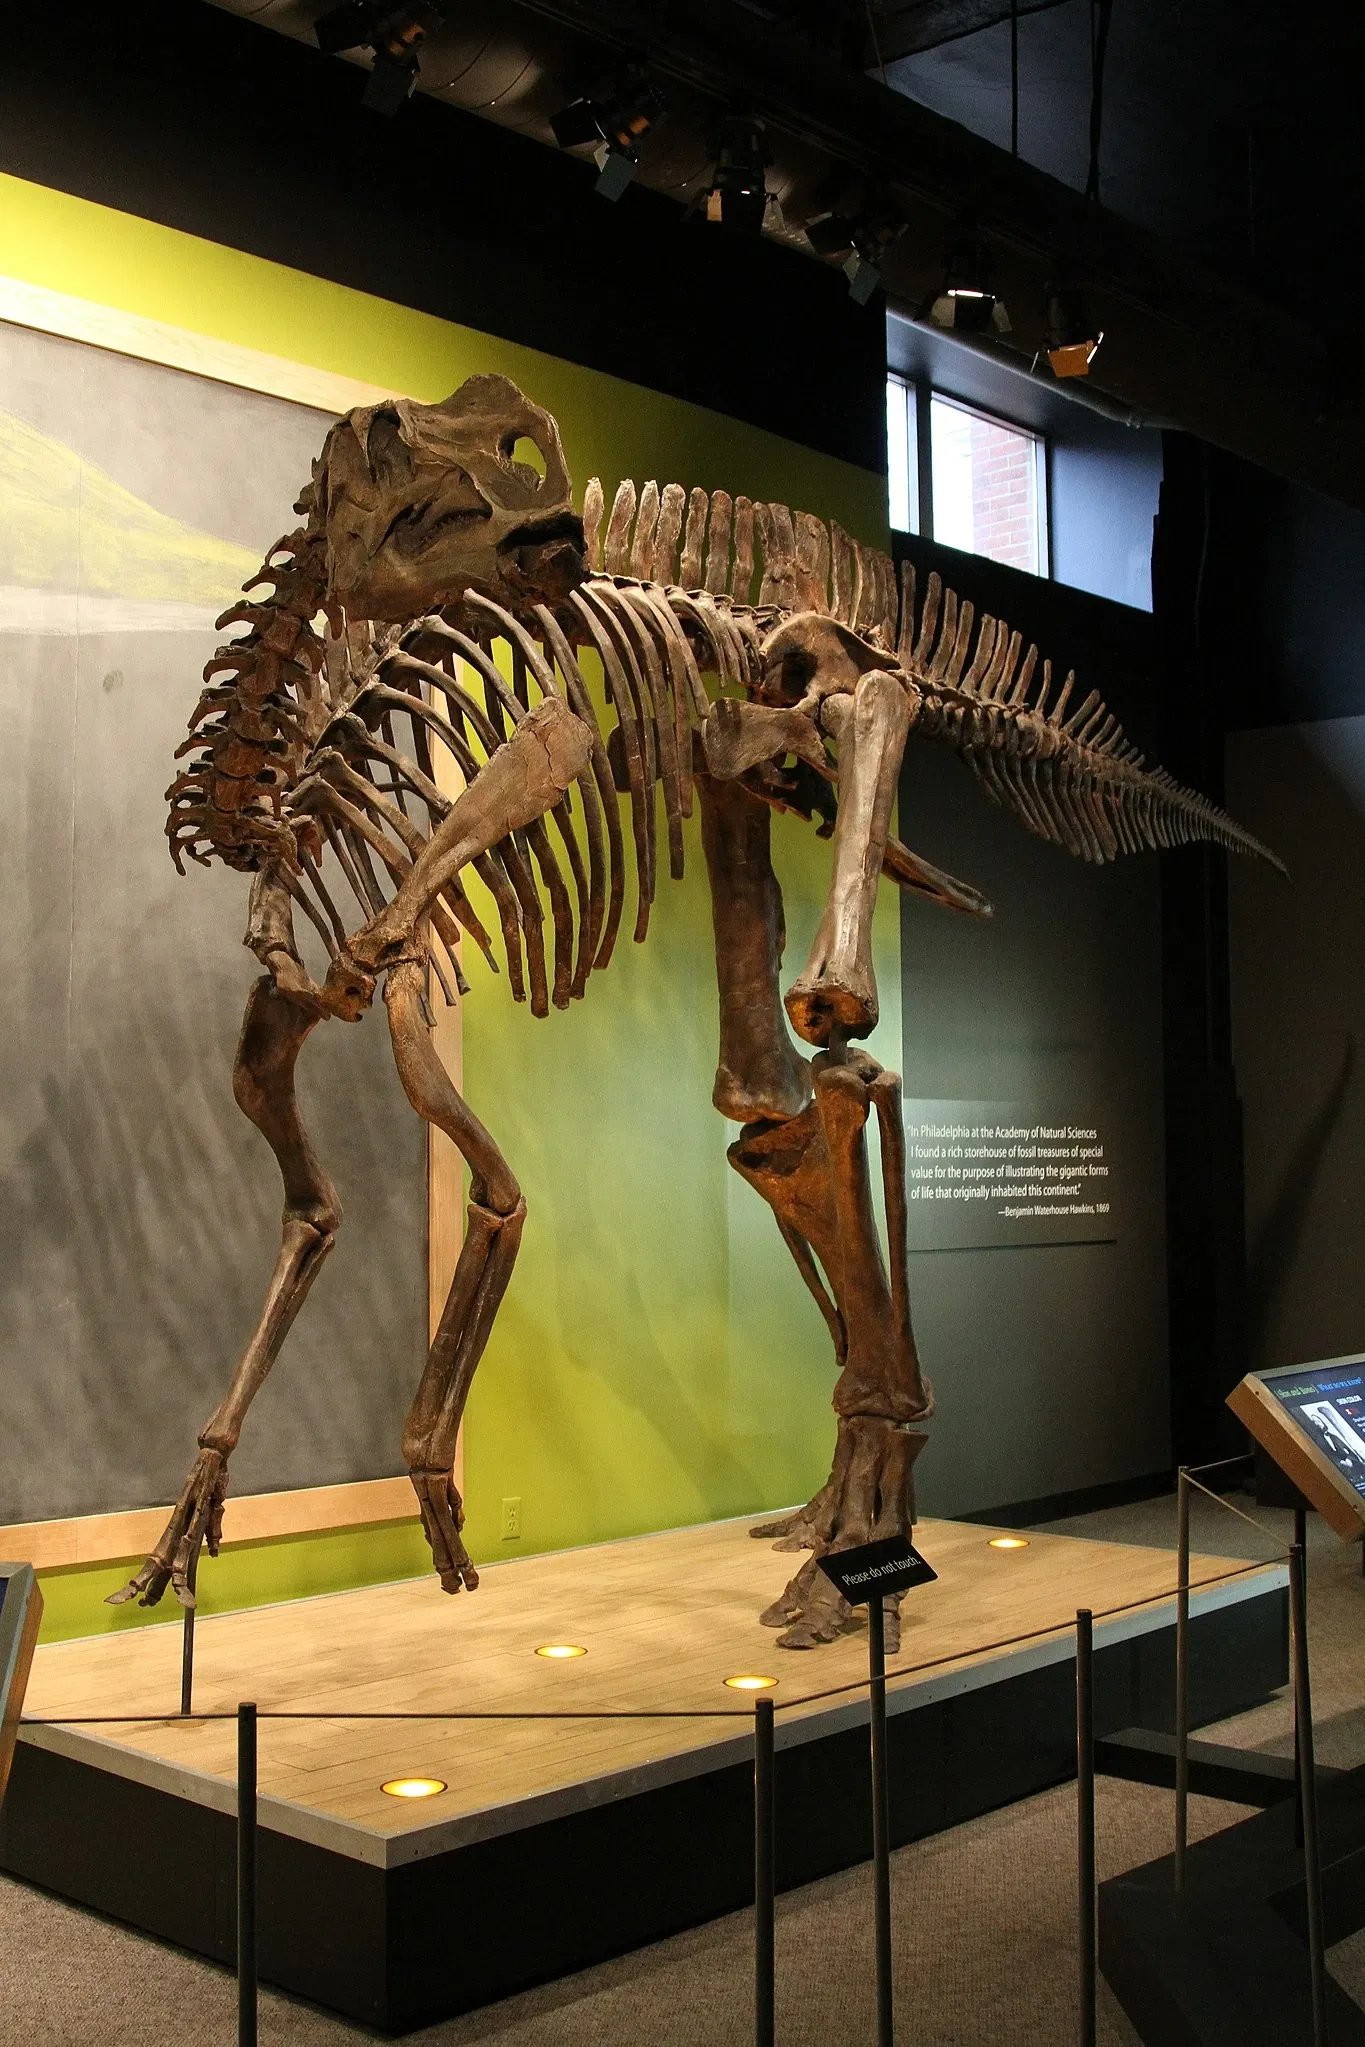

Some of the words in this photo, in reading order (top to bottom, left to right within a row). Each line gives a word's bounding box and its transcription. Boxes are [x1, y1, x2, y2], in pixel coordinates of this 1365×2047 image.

[921, 1125, 970, 1140] Philadelphia
[971, 1128, 979, 1137] at
[981, 1126, 993, 1138] the
[995, 1126, 1030, 1141] Academy
[1031, 1126, 1041, 1138] of
[1041, 1126, 1066, 1138] Natural
[1068, 1127, 1097, 1139] Sciences
[911, 1147, 914, 1157] I
[915, 1145, 939, 1158] found
[941, 1149, 946, 1158] a
[948, 1146, 962, 1158] rich
[965, 1146, 1007, 1158] storehouse
[1008, 1146, 1017, 1158] of
[1017, 1146, 1036, 1158] fossil
[1037, 1148, 1070, 1157] treasures
[1071, 1146, 1079, 1157] of
[1080, 1146, 1103, 1160] special
[911, 1166, 933, 1178] value
[935, 1165, 946, 1178] for
[948, 1166, 960, 1178] the
[963, 1168, 995, 1180] purpose
[997, 1165, 1005, 1177] of
[1006, 1165, 1045, 1180] illustrating
[1046, 1165, 1058, 1177] the
[1059, 1165, 1088, 1180] gigantic
[1089, 1164, 1108, 1176] forms
[911, 1186, 921, 1200] of
[921, 1186, 933, 1199] life
[936, 1187, 952, 1199] that
[954, 1185, 990, 1201] originally
[991, 1185, 1027, 1197] inhabited
[1028, 1184, 1042, 1196] this
[1034, 1205, 1069, 1216] Waterhouse
[1070, 1204, 1095, 1214] Hawkins,
[1096, 1203, 1109, 1213] 1869
[841, 1571, 872, 1587] Please
[869, 1566, 882, 1578] do
[881, 1561, 898, 1575] not
[894, 1555, 921, 1570] touch.
